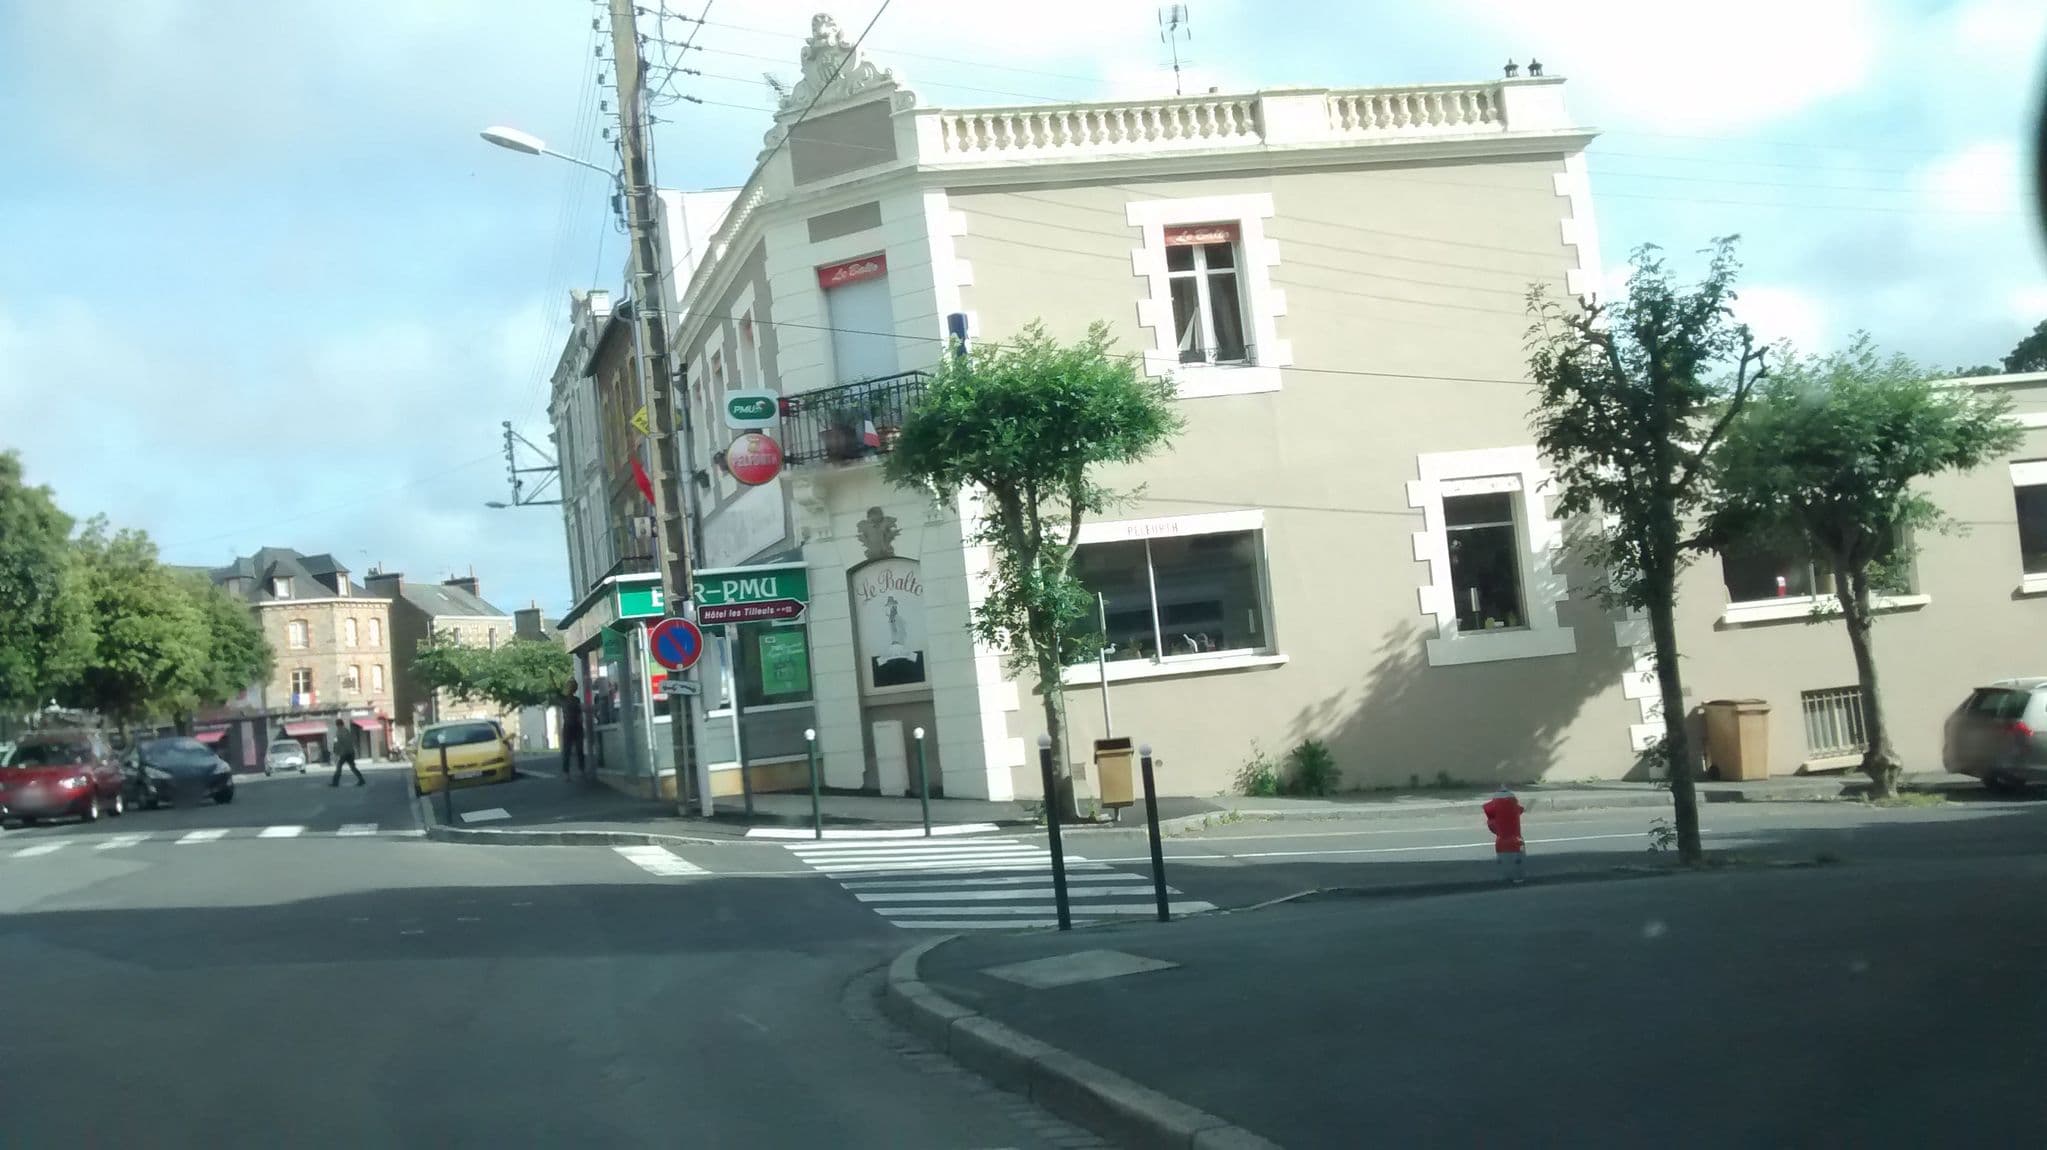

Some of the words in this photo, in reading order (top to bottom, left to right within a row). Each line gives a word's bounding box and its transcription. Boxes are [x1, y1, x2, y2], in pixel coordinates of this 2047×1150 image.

[733, 405, 756, 414] PMU
[651, 576, 778, 608] BR-PMU
[857, 579, 877, 602] Le
[878, 568, 924, 597] Balto
[704, 609, 726, 619] Hôtel
[729, 608, 741, 617] les
